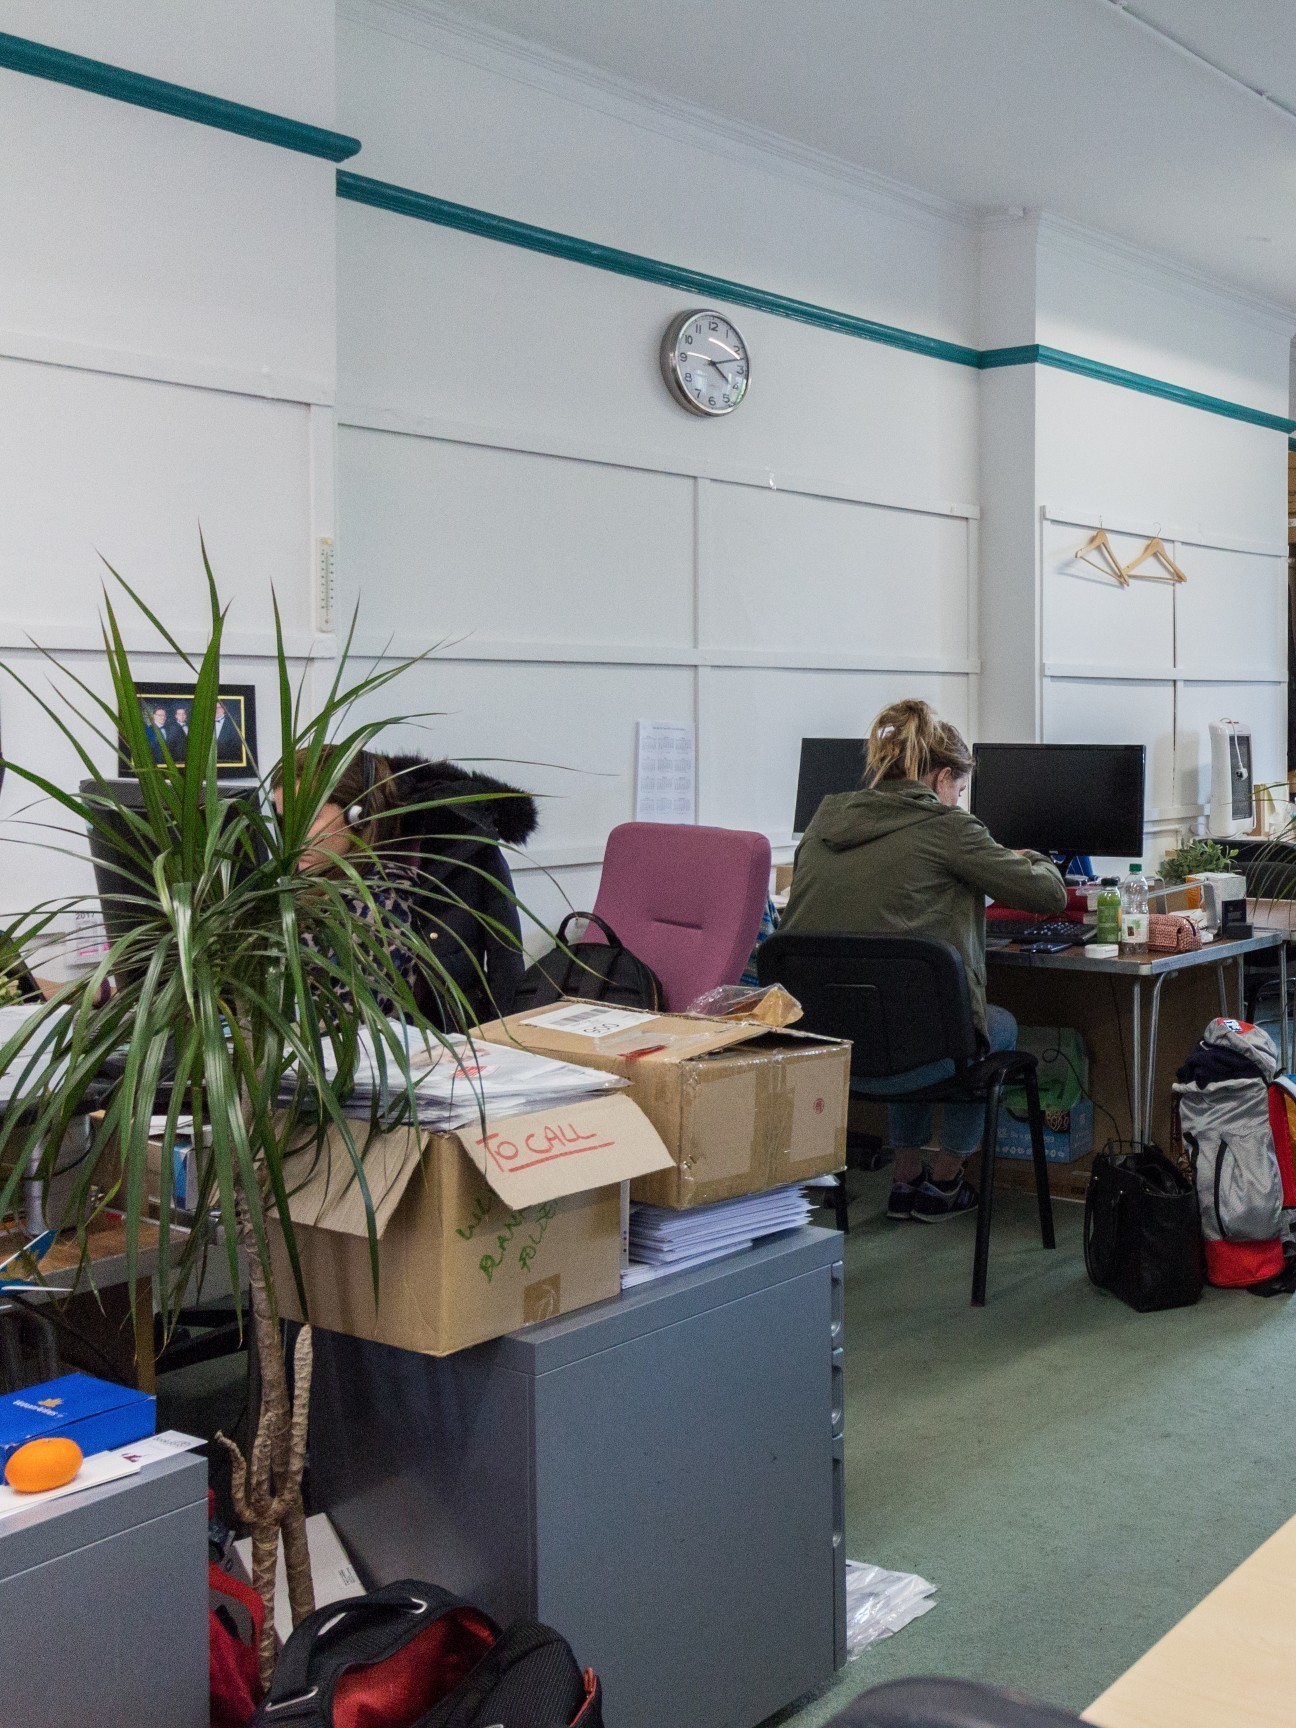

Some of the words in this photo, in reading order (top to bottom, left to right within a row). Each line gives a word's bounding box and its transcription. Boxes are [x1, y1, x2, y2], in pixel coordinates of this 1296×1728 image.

[695, 324, 702, 335] 11
[708, 321, 719, 332] 12
[684, 334, 693, 345] 10
[680, 352, 688, 362] 9
[736, 365, 745, 375] 3
[684, 372, 693, 383] 8
[694, 388, 702, 399] 7
[722, 393, 731, 404] 5
[708, 396, 717, 406] 6
[475, 1132, 519, 1172] TO
[525, 1123, 597, 1154] CALL
